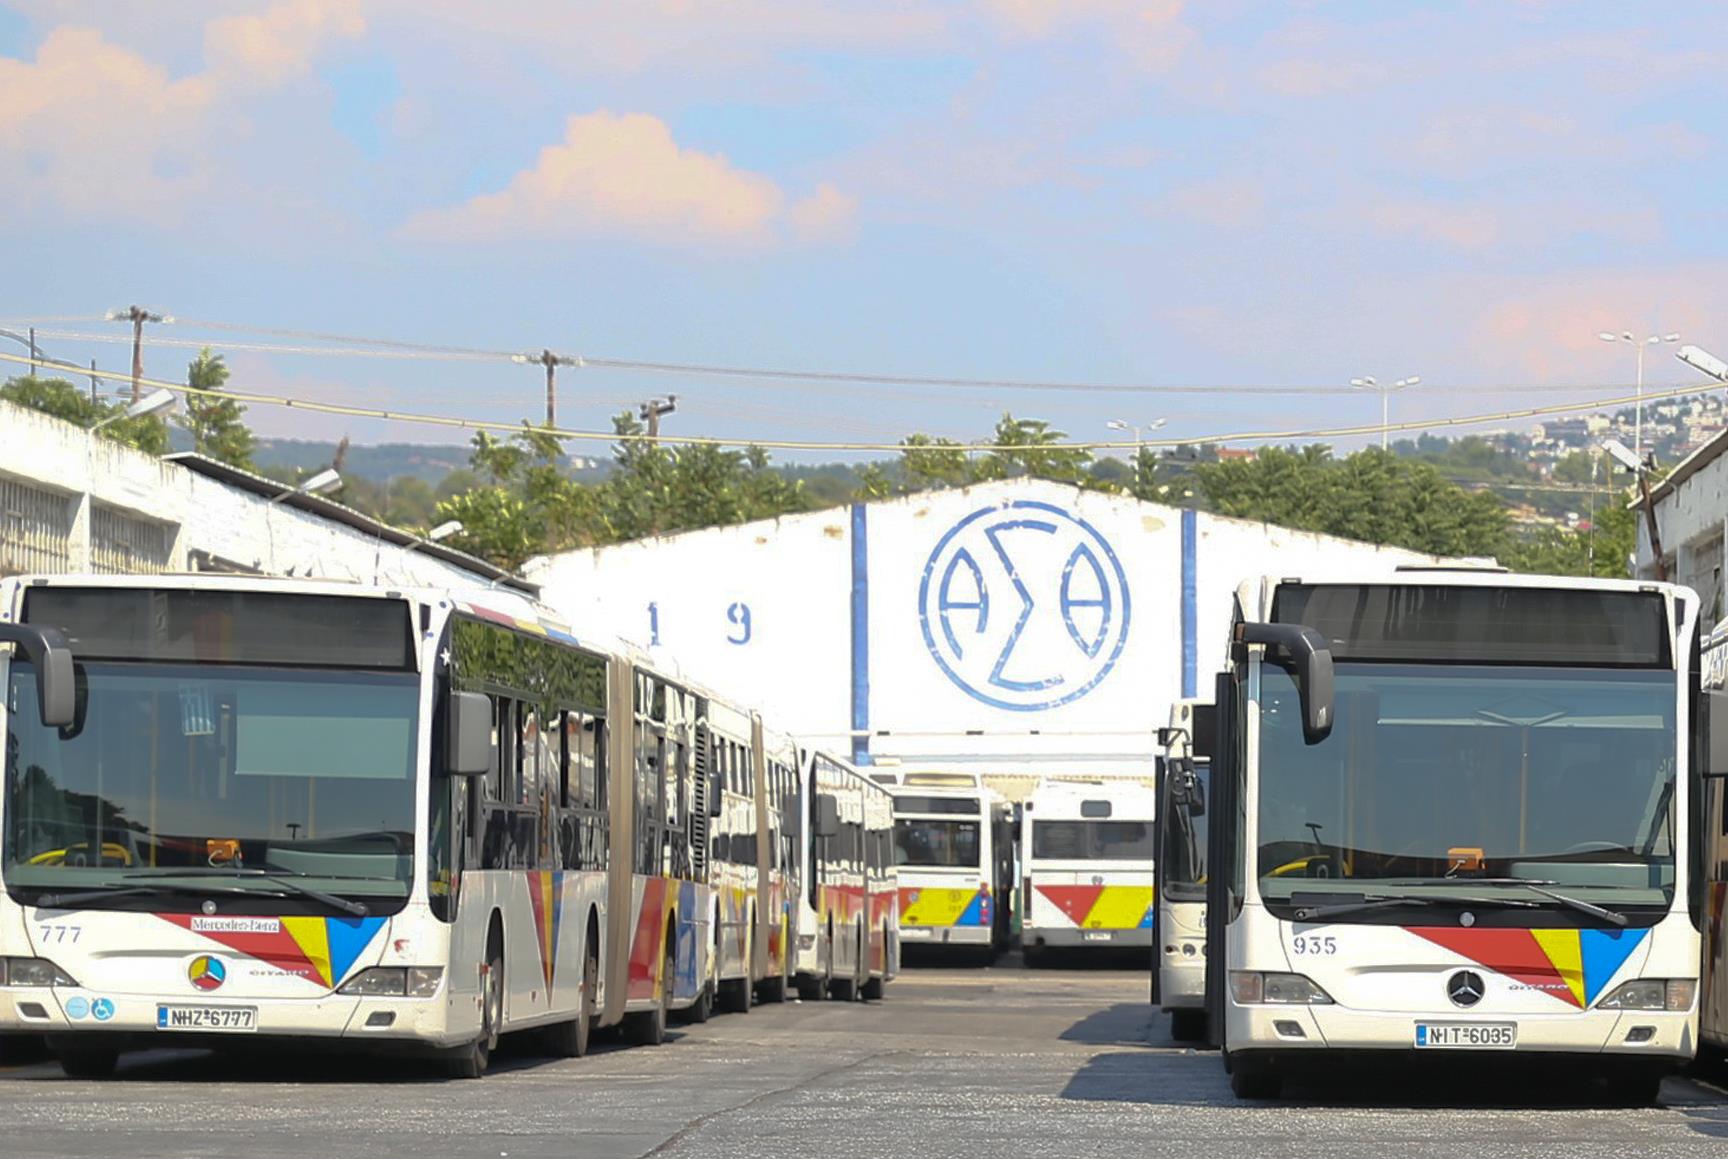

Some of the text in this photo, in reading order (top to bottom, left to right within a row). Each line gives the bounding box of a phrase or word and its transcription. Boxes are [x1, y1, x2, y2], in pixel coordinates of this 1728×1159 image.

[727, 601, 752, 645] 9
[40, 925, 82, 943] 777
[1293, 936, 1337, 955] 935
